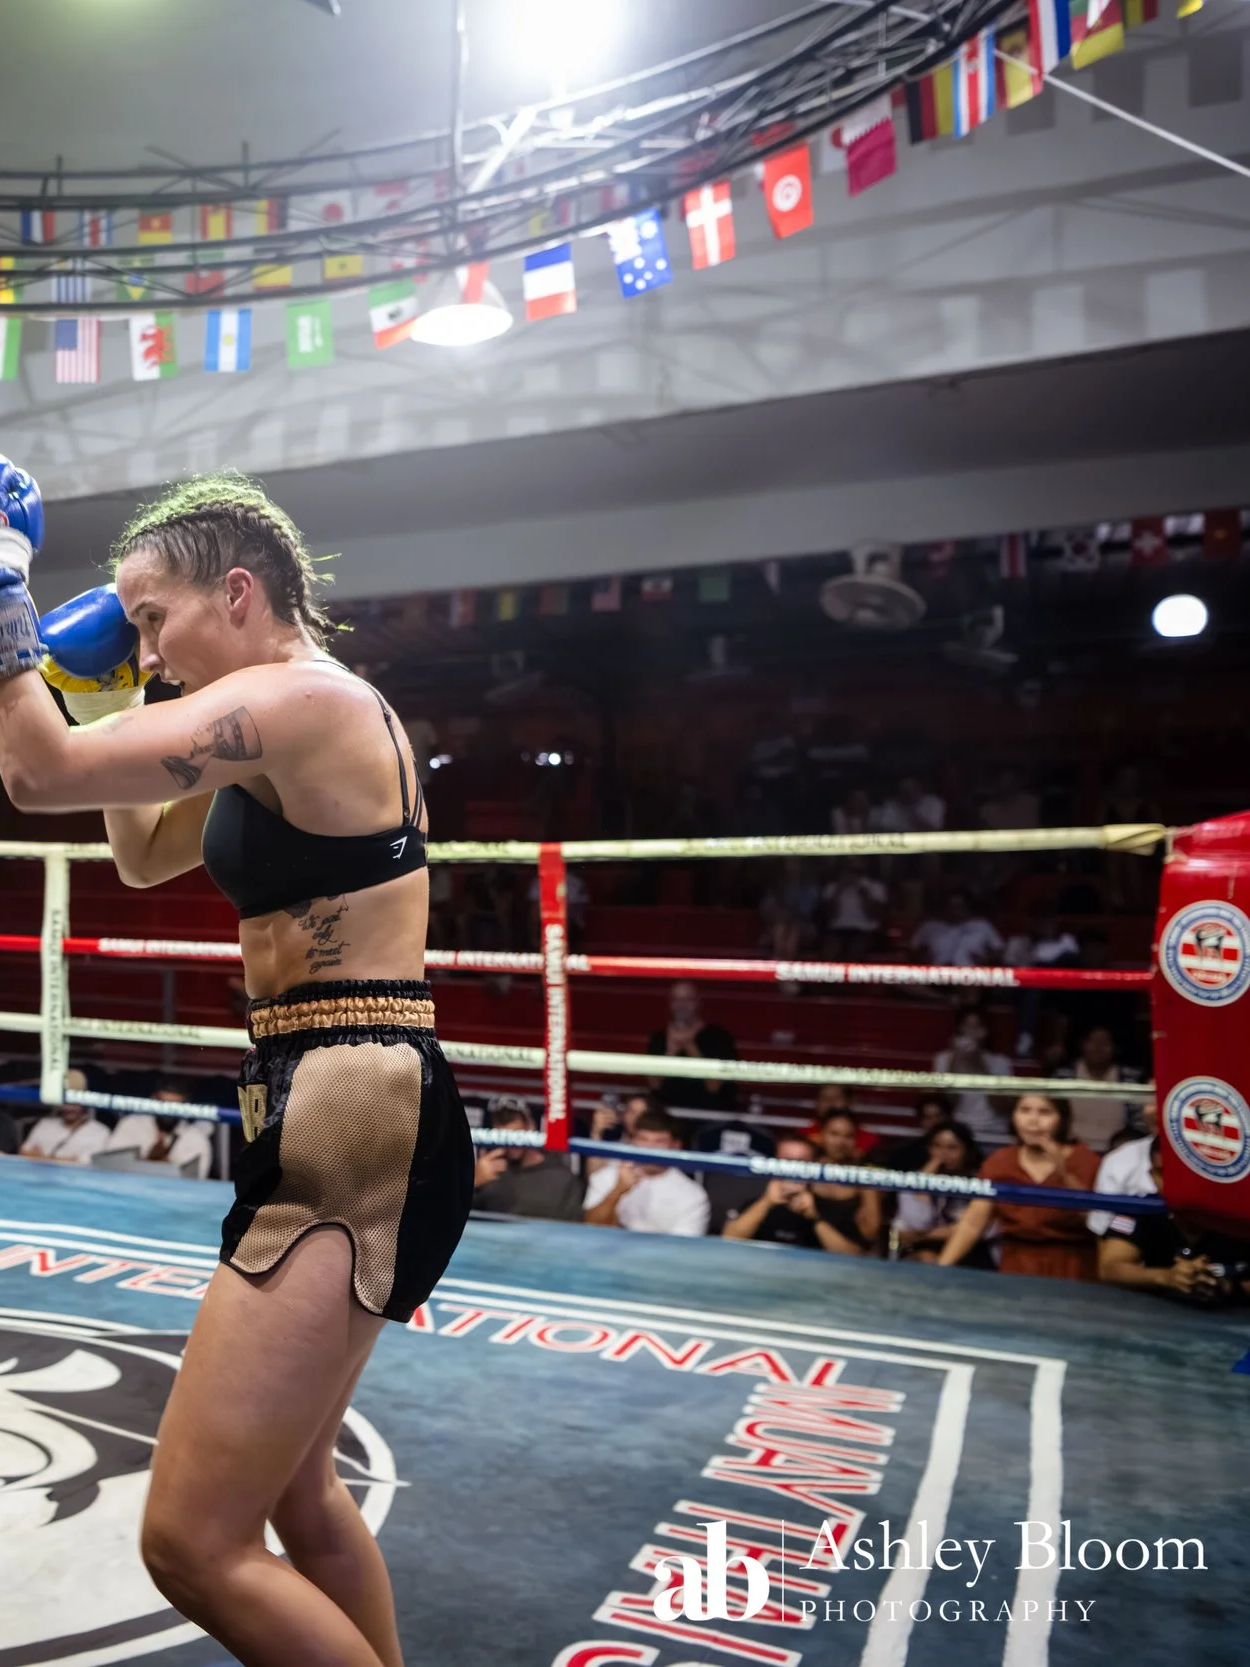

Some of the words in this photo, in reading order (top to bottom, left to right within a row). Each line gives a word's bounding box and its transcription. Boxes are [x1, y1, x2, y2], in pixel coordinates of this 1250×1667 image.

[146, 939, 242, 957] INTERNATIONA
[775, 960, 846, 983] SAMUI
[847, 964, 1021, 988] INTERNATIONAL
[750, 1155, 822, 1181] SAMUI
[823, 1163, 998, 1197] INTERNATIONAL
[701, 1382, 906, 1517] MUAY
